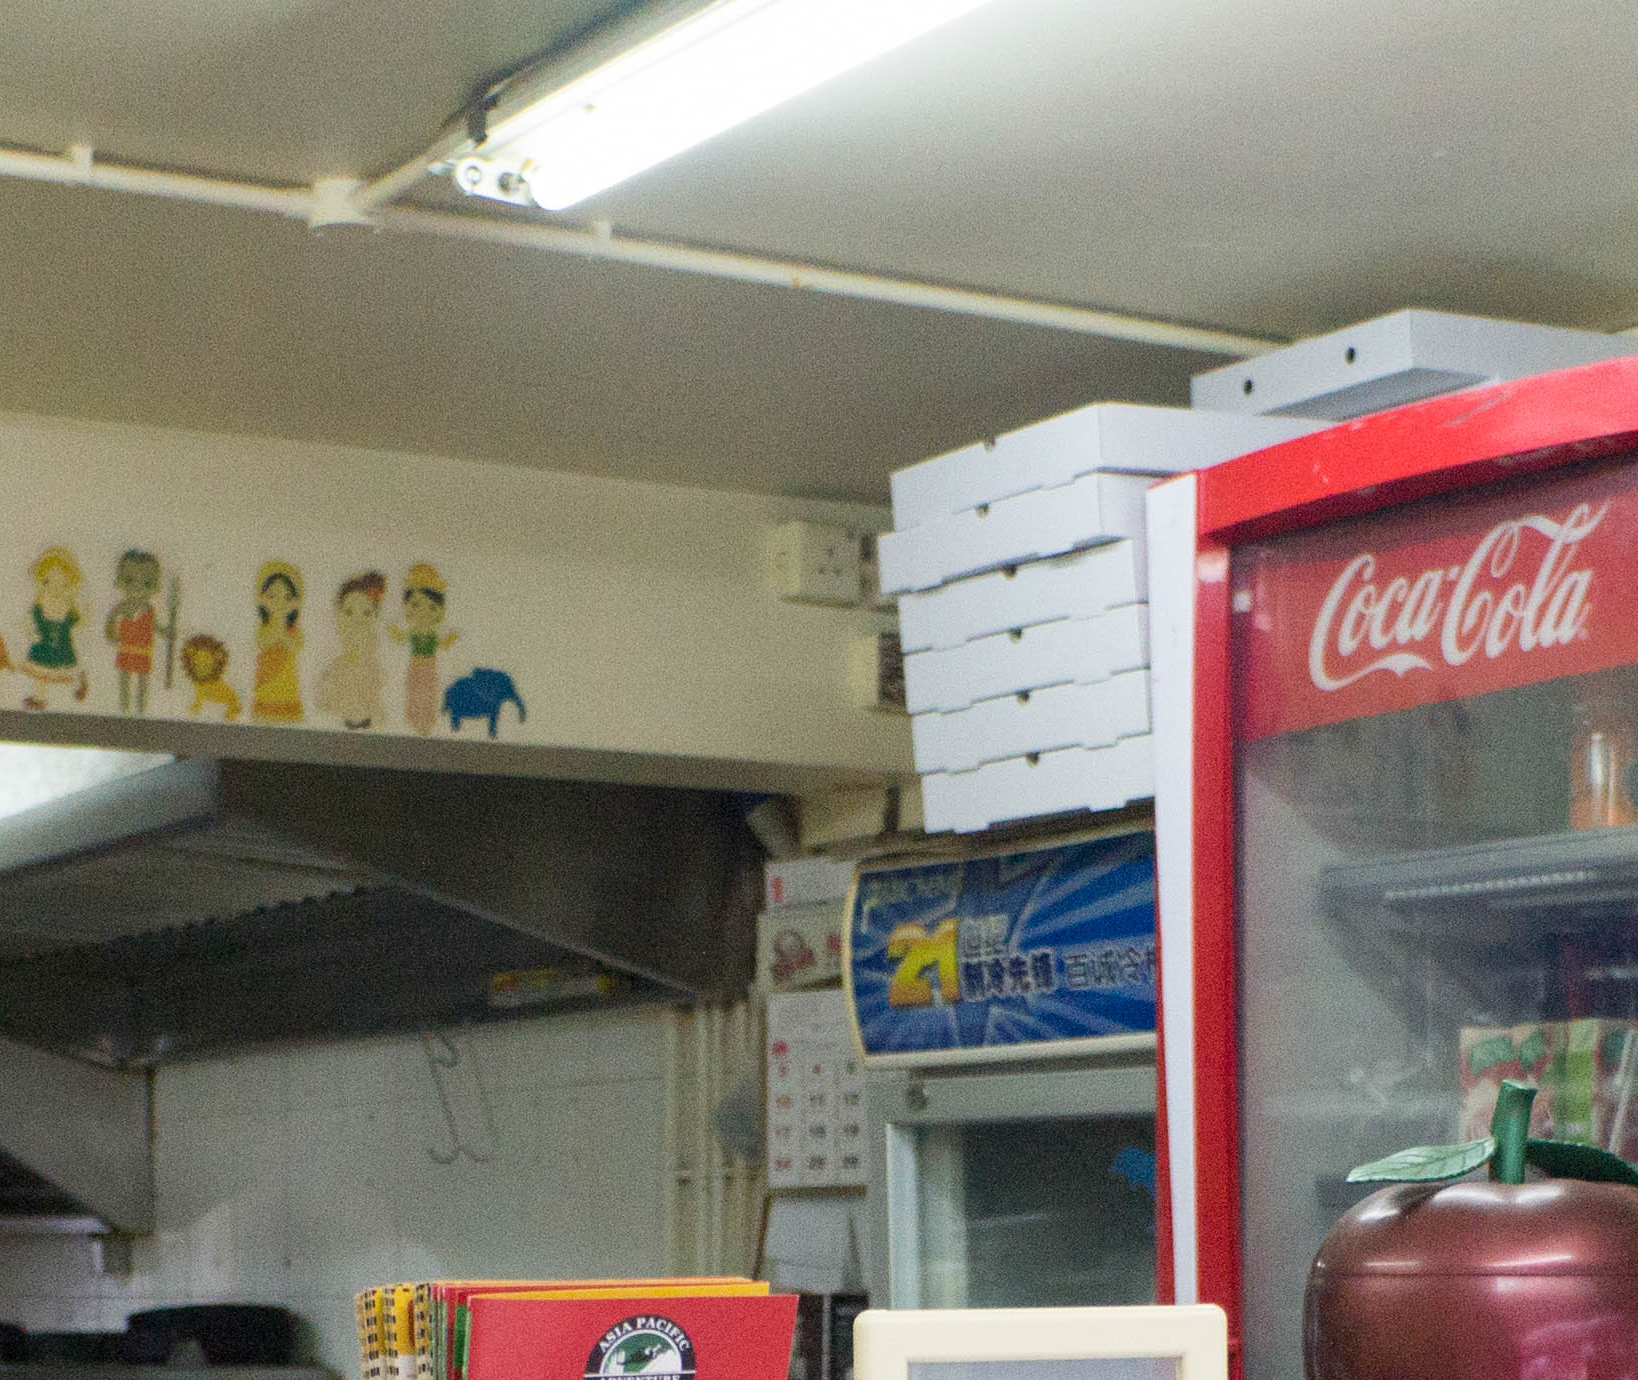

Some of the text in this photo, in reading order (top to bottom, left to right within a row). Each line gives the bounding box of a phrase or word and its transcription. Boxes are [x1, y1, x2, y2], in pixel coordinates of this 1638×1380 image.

[1309, 501, 1609, 691] Coca-Cola
[598, 1315, 691, 1354] ASIA PACIFIC
